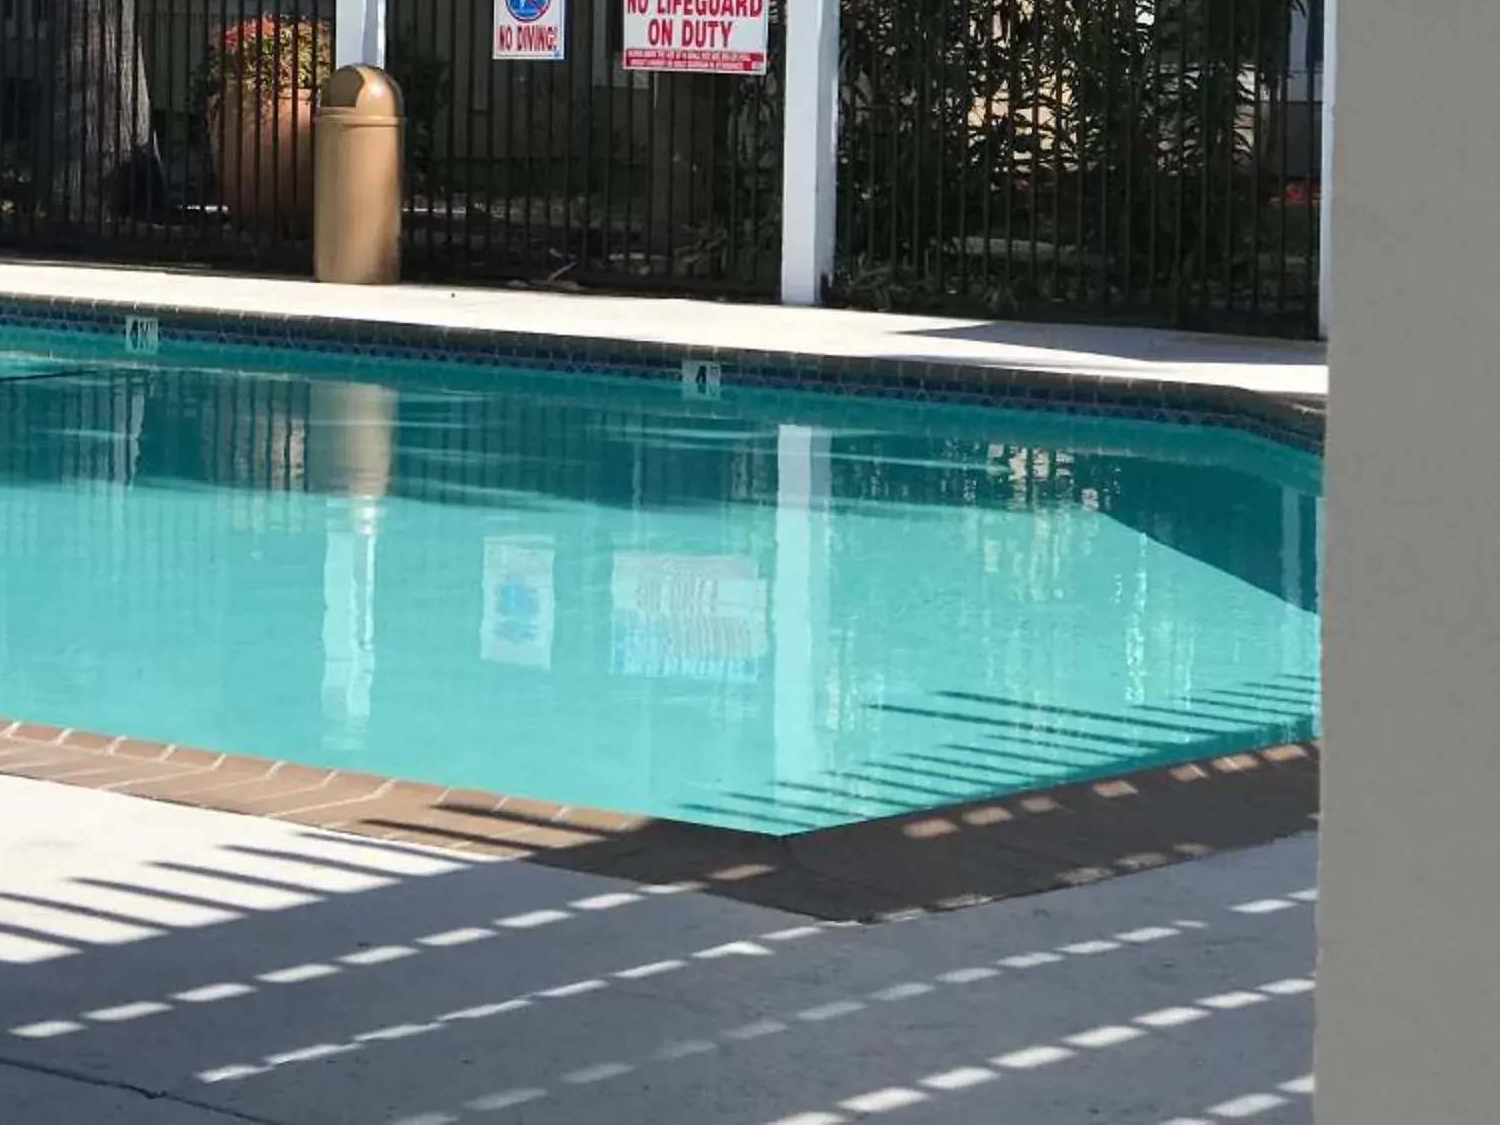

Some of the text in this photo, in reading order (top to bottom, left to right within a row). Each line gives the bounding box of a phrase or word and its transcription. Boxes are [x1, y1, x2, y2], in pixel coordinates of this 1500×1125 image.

[499, 26, 513, 51] NO
[647, 18, 733, 48] ON DUTY
